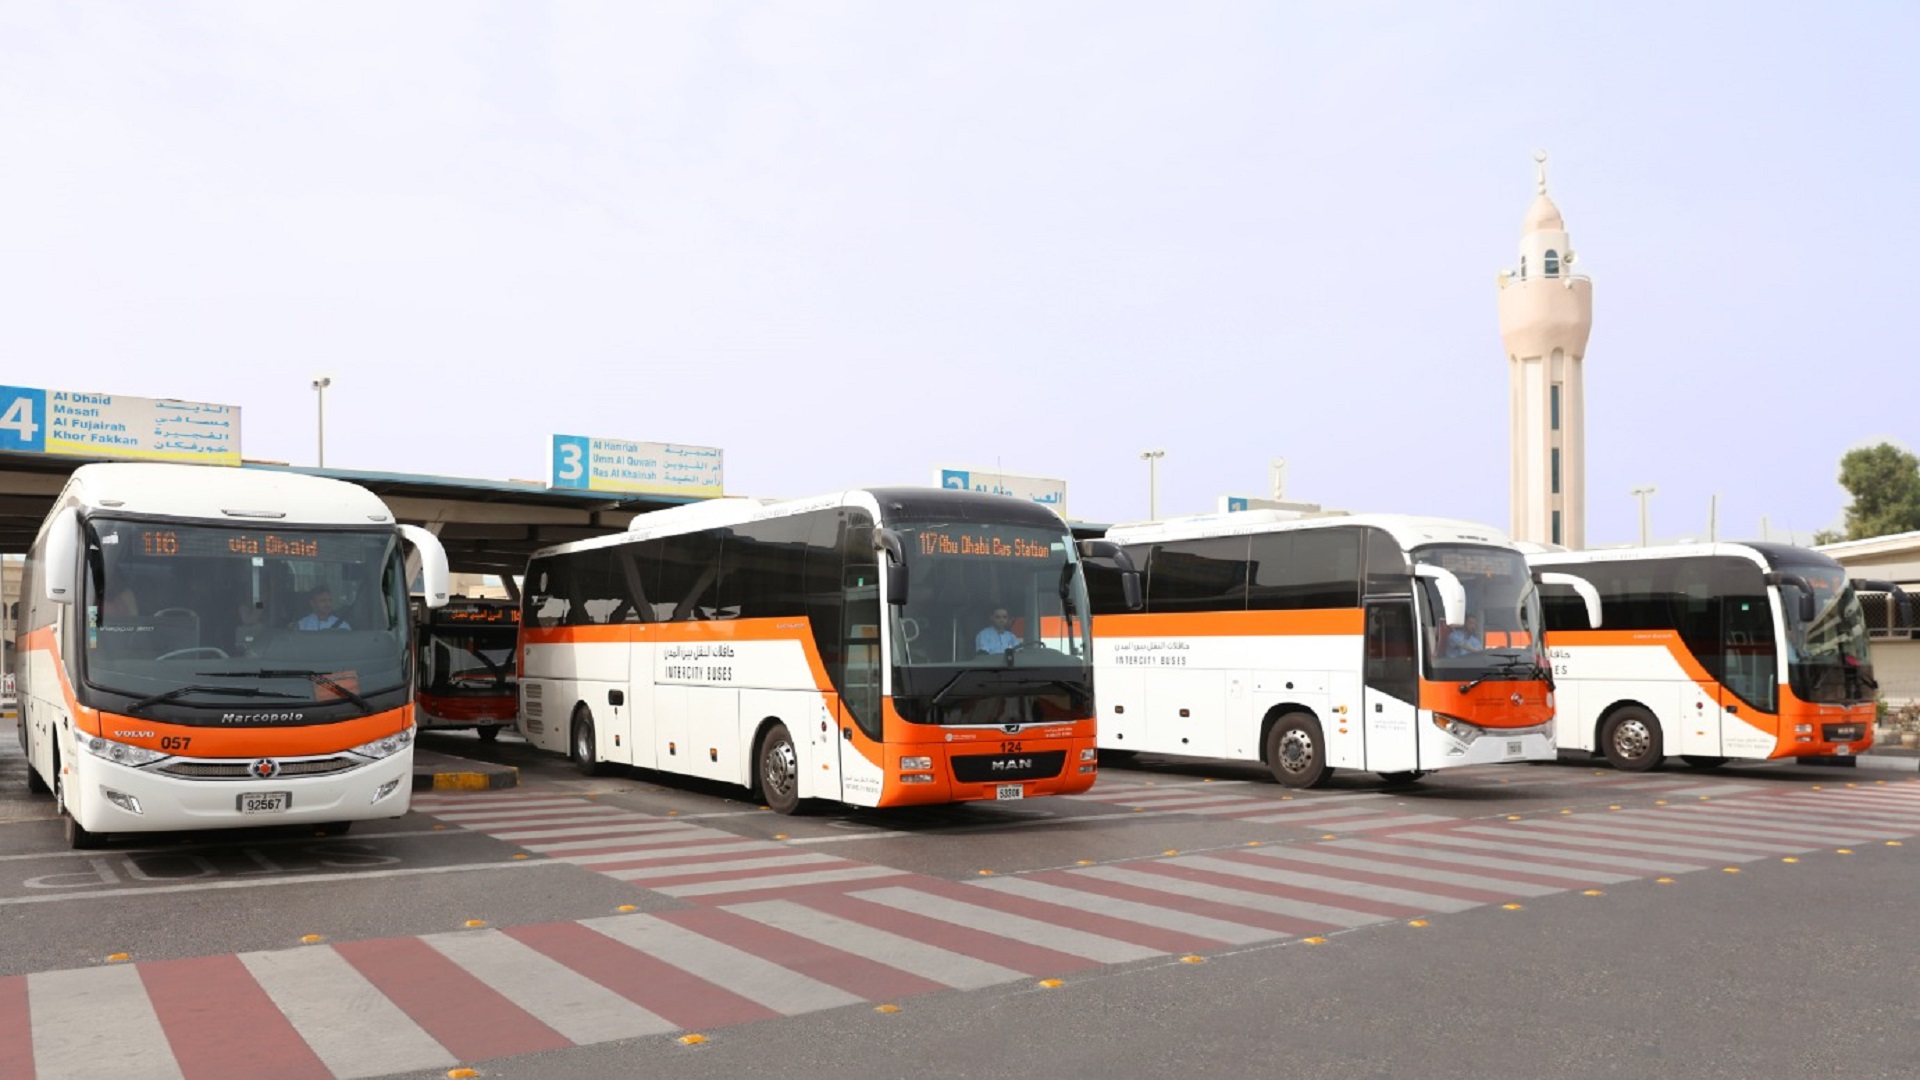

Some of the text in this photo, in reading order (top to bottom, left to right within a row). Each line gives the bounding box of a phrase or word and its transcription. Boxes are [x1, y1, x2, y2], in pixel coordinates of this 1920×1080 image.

[53, 392, 112, 406] Al Dhaid
[53, 404, 99, 418] Masafi
[155, 401, 230, 414] الذيد
[0, 396, 38, 442] 4
[53, 417, 126, 432] Al Fujairah
[53, 430, 138, 446] Khor Fakkan
[154, 426, 229, 440] الفجيرة
[593, 441, 602, 450] Al
[558, 443, 583, 480] 3
[593, 454, 614, 464] Umm
[616, 456, 625, 465] Al
[593, 467, 609, 478] Ras
[611, 468, 620, 478] Al
[142, 531, 318, 557] 116 via Dhaid
[919, 531, 1050, 558] 117 Abu Dhabi Bus Station
[712, 643, 735, 658] حافلات
[1115, 655, 1187, 666] INTERCITY BUSES
[665, 666, 732, 681] INTERCITY BUSES
[221, 712, 304, 724] Marcopolo
[113, 729, 155, 738] VOLVO
[160, 736, 192, 750] 057
[1000, 741, 1022, 753] 124
[992, 758, 1032, 771] MAN
[247, 798, 282, 811] 92567
